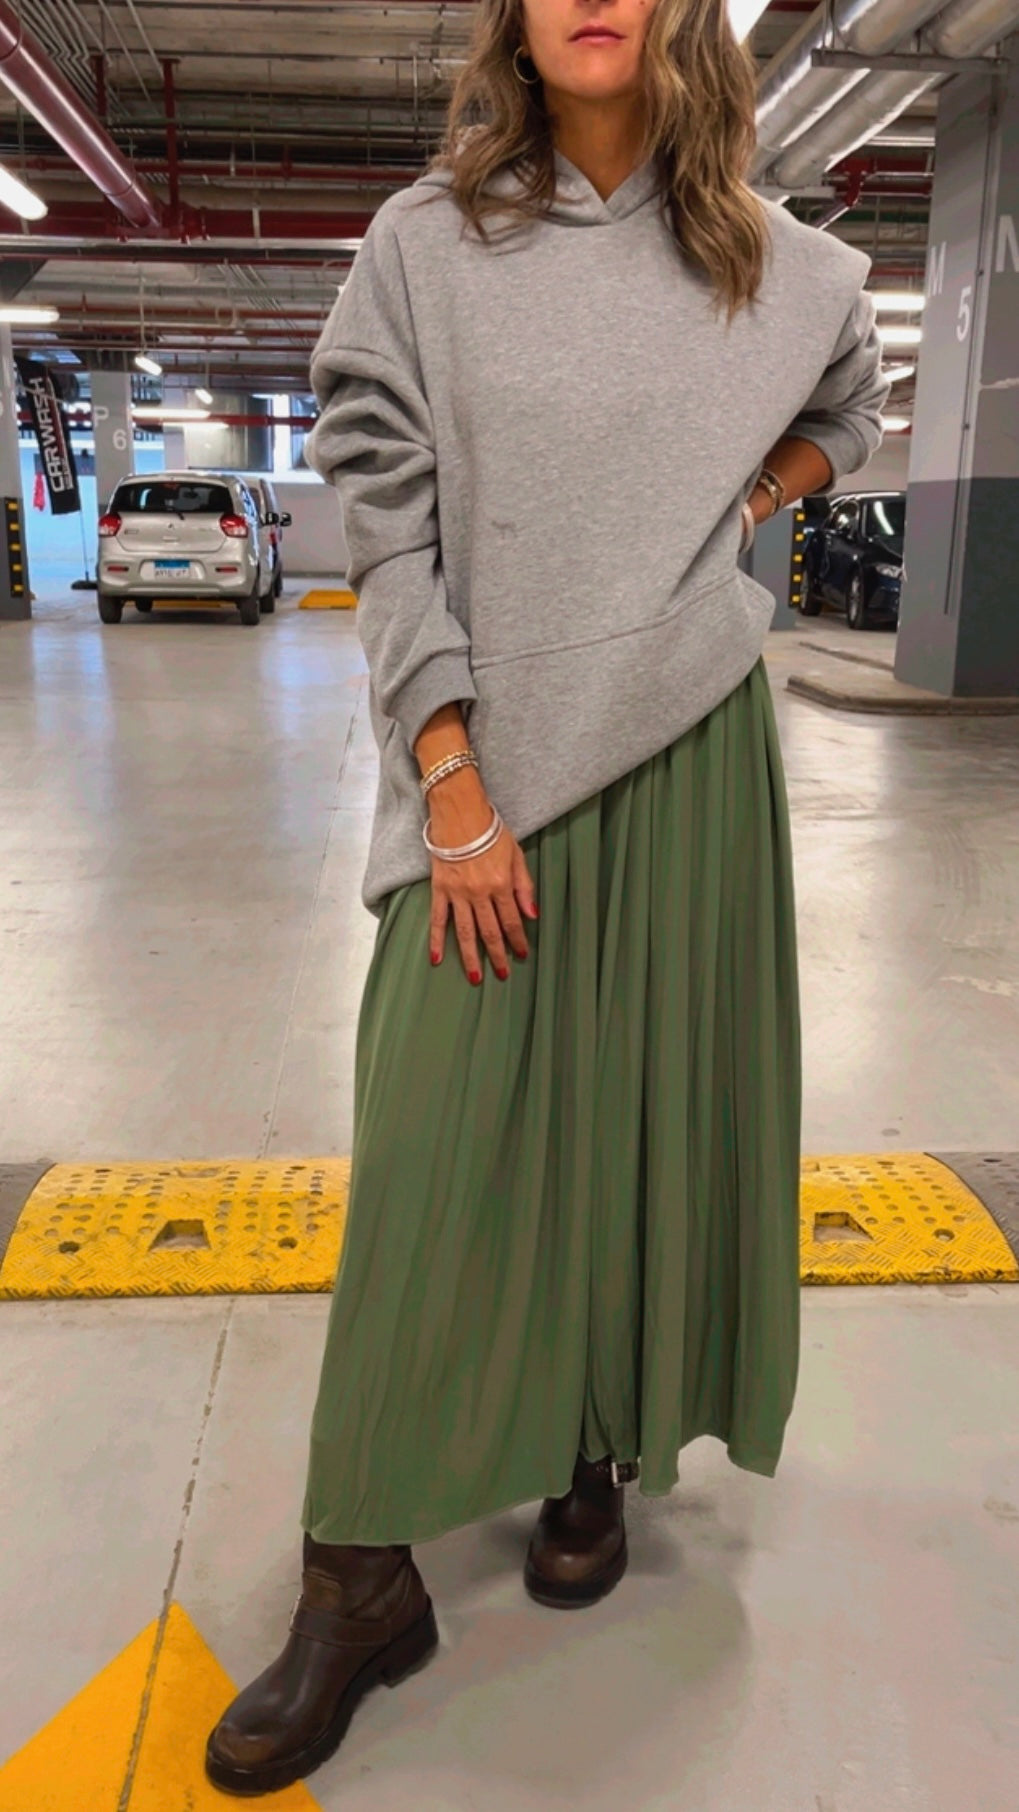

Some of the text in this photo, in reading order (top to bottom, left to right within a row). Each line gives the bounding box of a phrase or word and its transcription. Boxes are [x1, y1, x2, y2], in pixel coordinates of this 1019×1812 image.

[929, 241, 947, 297] M
[956, 285, 972, 342] 5
[93, 406, 110, 428] P
[113, 428, 127, 451] 6
